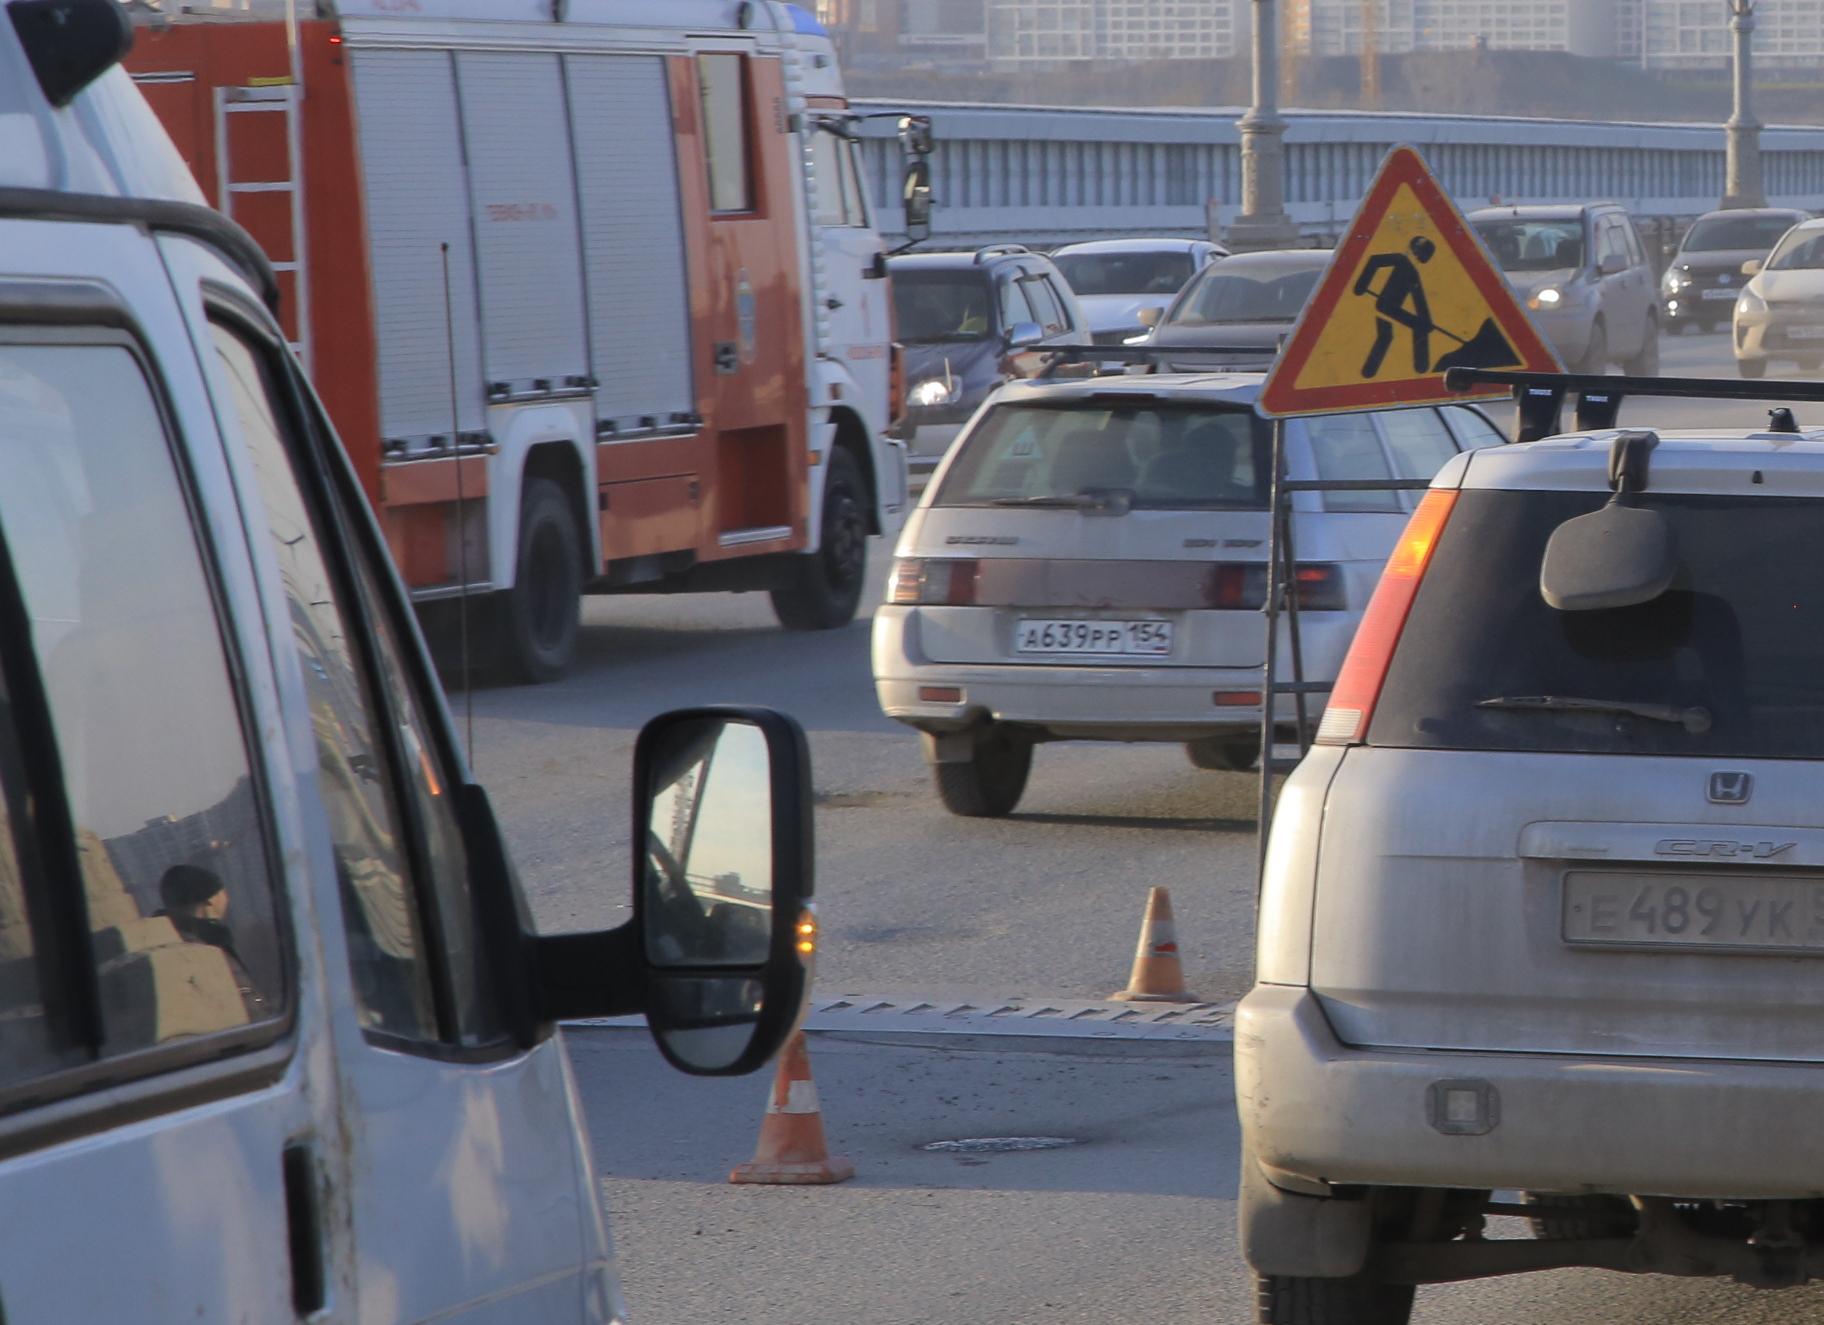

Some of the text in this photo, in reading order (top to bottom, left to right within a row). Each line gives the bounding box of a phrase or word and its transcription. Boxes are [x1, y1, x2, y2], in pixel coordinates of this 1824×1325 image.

[1024, 623, 1169, 648] А639РР 154
[1654, 838, 1799, 859] CR-V
[1589, 884, 1795, 938] Е489УК
